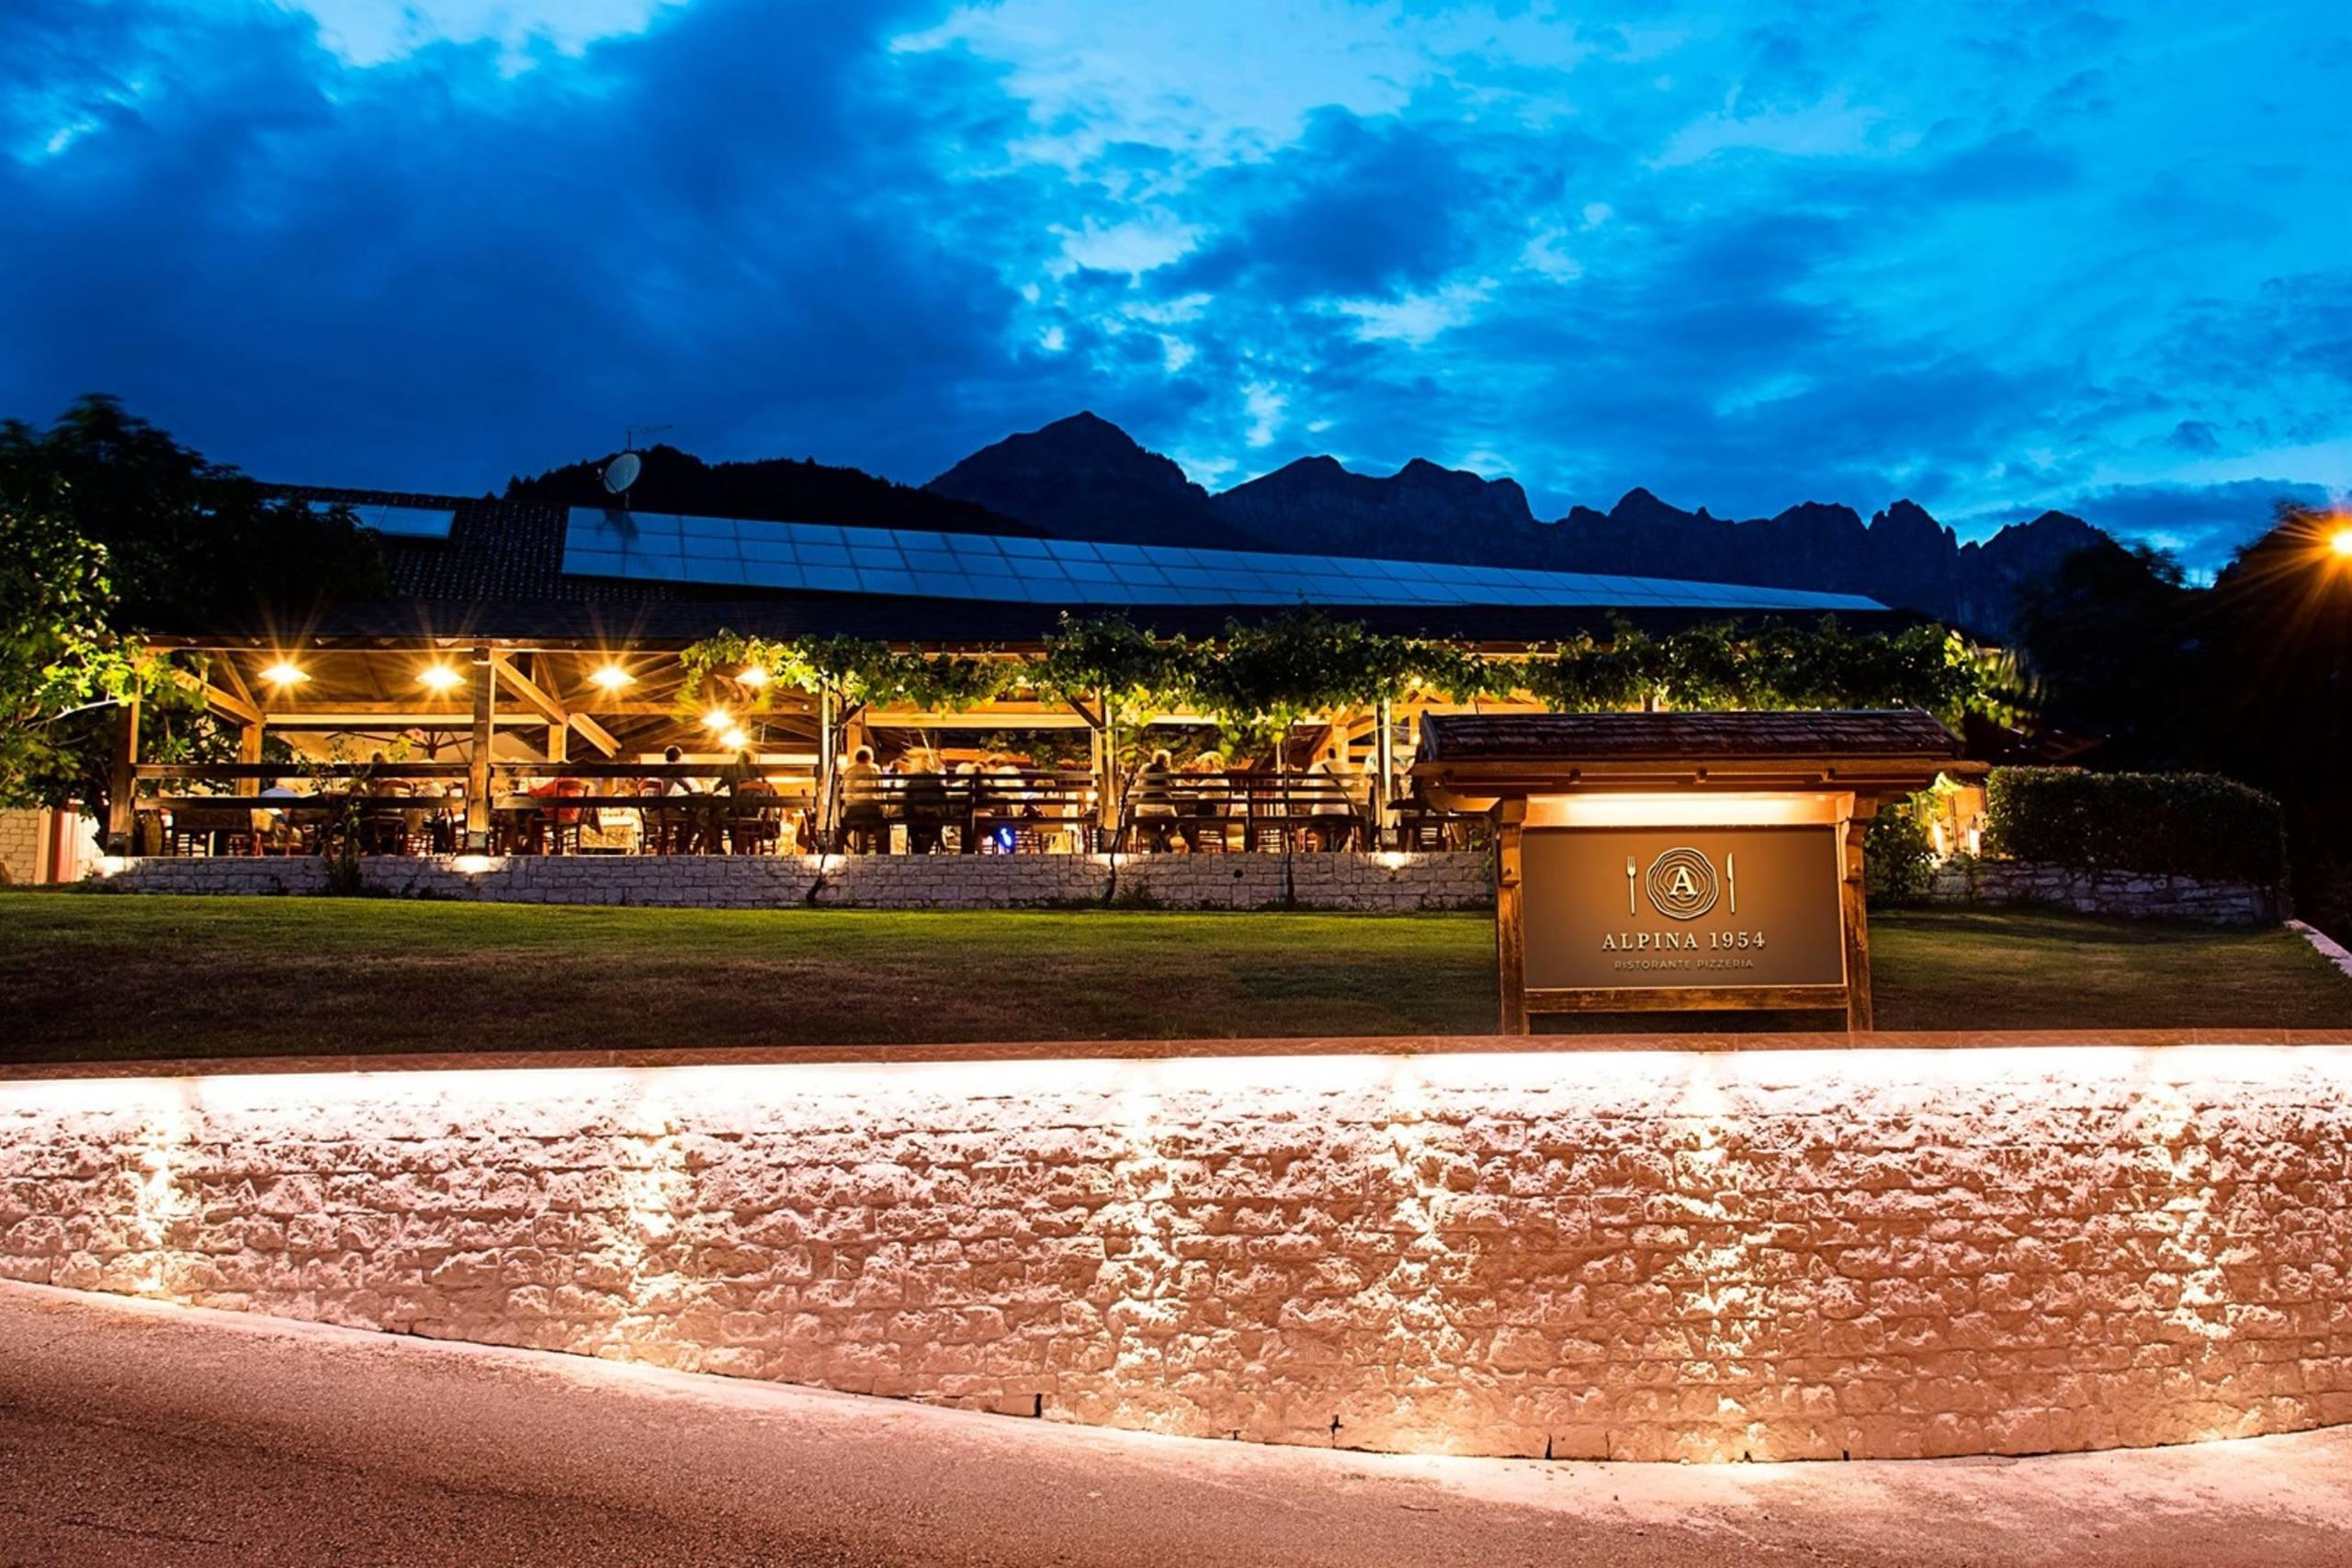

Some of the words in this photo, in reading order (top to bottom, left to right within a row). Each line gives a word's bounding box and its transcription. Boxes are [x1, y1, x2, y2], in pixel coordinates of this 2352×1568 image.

[1668, 866, 1698, 897] A
[1602, 932, 1698, 950] ALPINA
[1709, 931, 1765, 949] 1954
[1614, 959, 1690, 970] RISTORANTE
[1697, 958, 1754, 969] PIZZERIA
